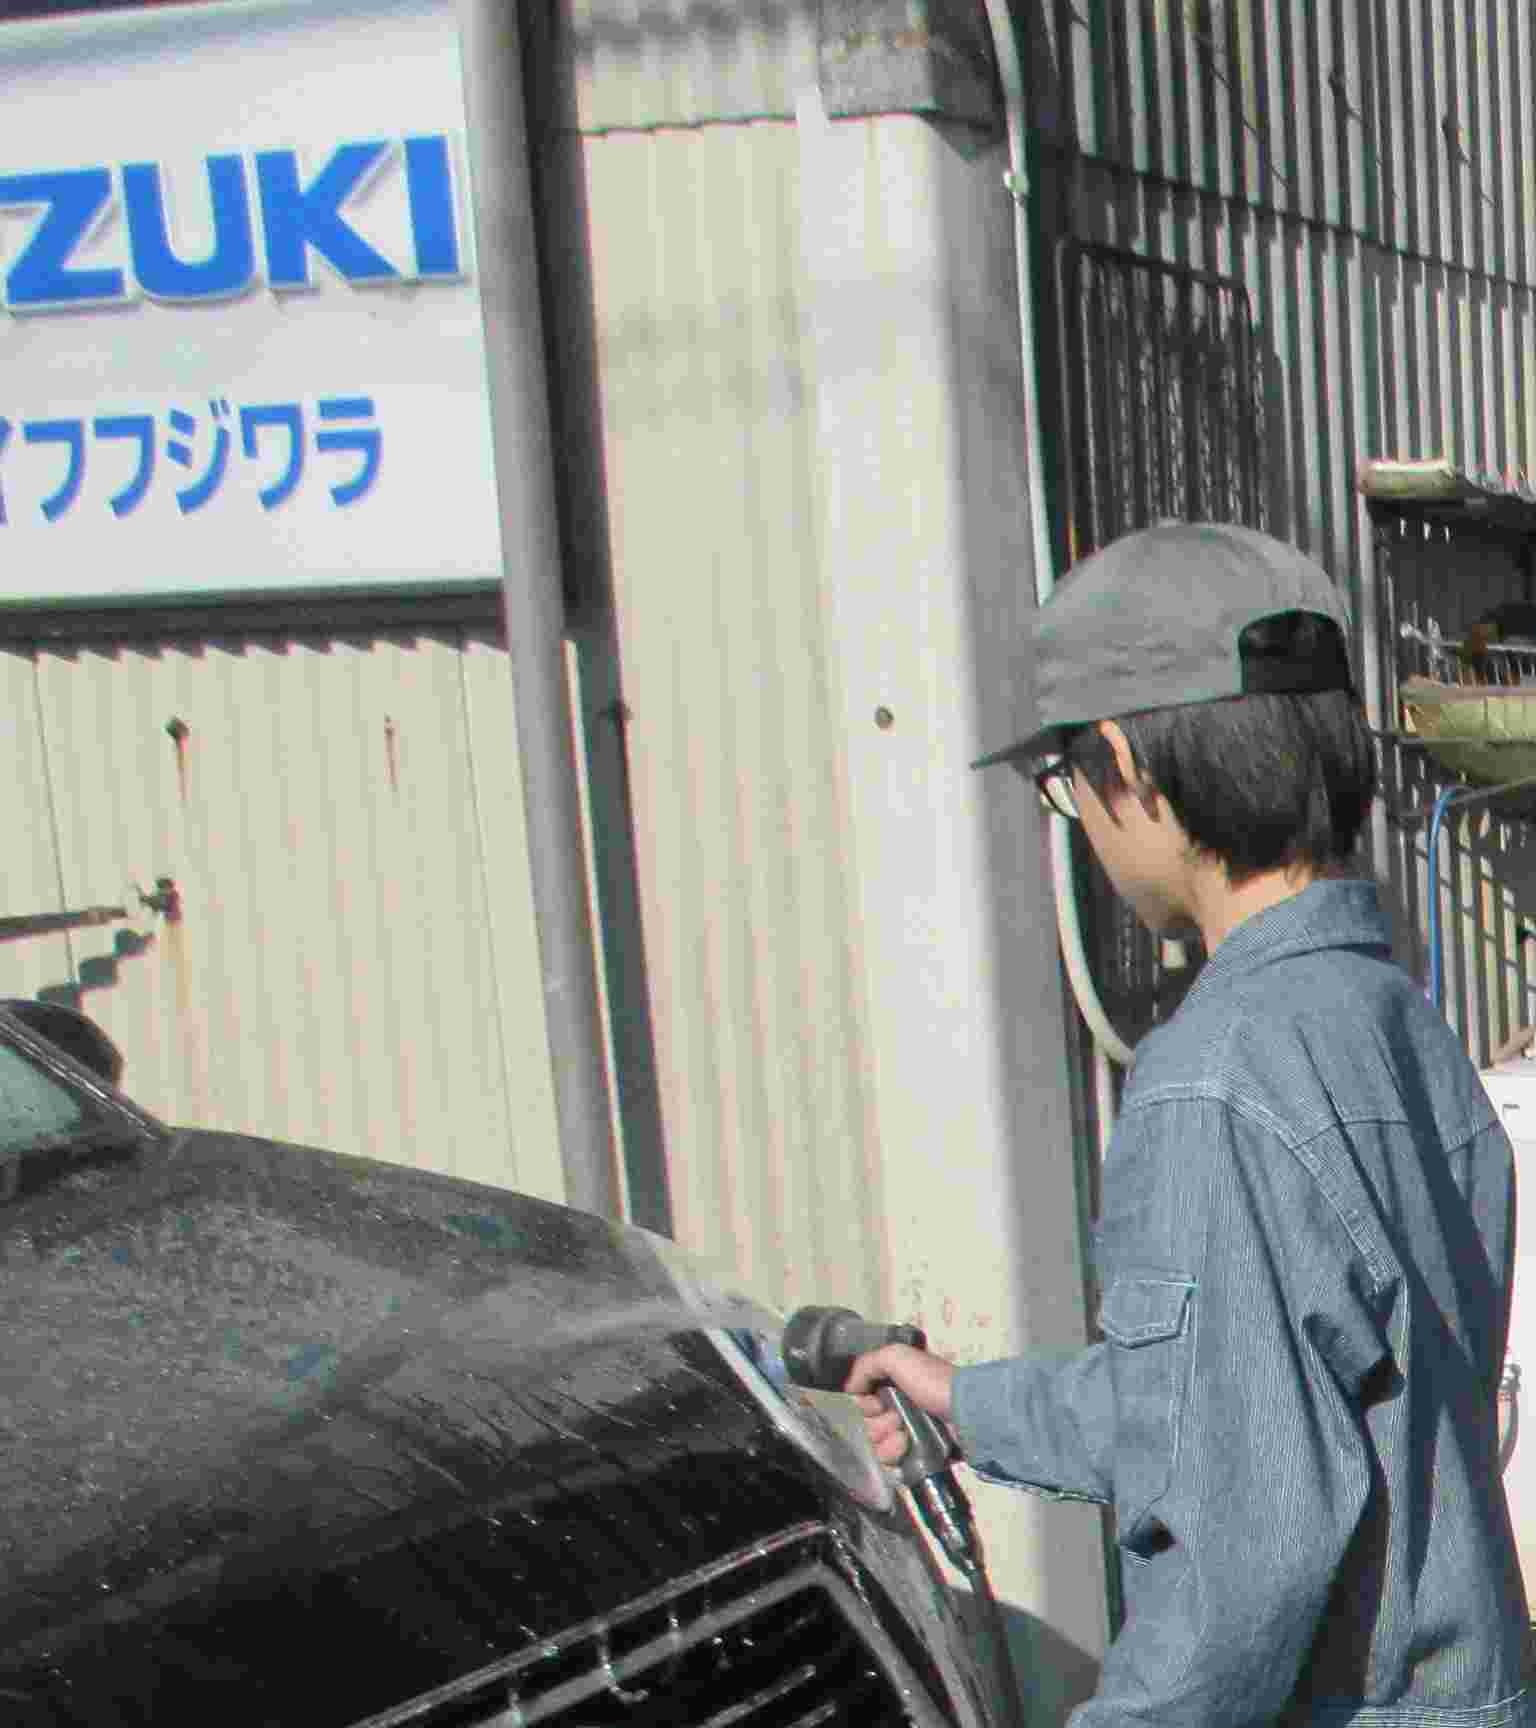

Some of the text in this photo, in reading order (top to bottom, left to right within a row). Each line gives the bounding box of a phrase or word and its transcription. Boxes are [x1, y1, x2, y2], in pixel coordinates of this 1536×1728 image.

[0, 134, 462, 303] ZUKI
[0, 395, 382, 525] フフジワラ
